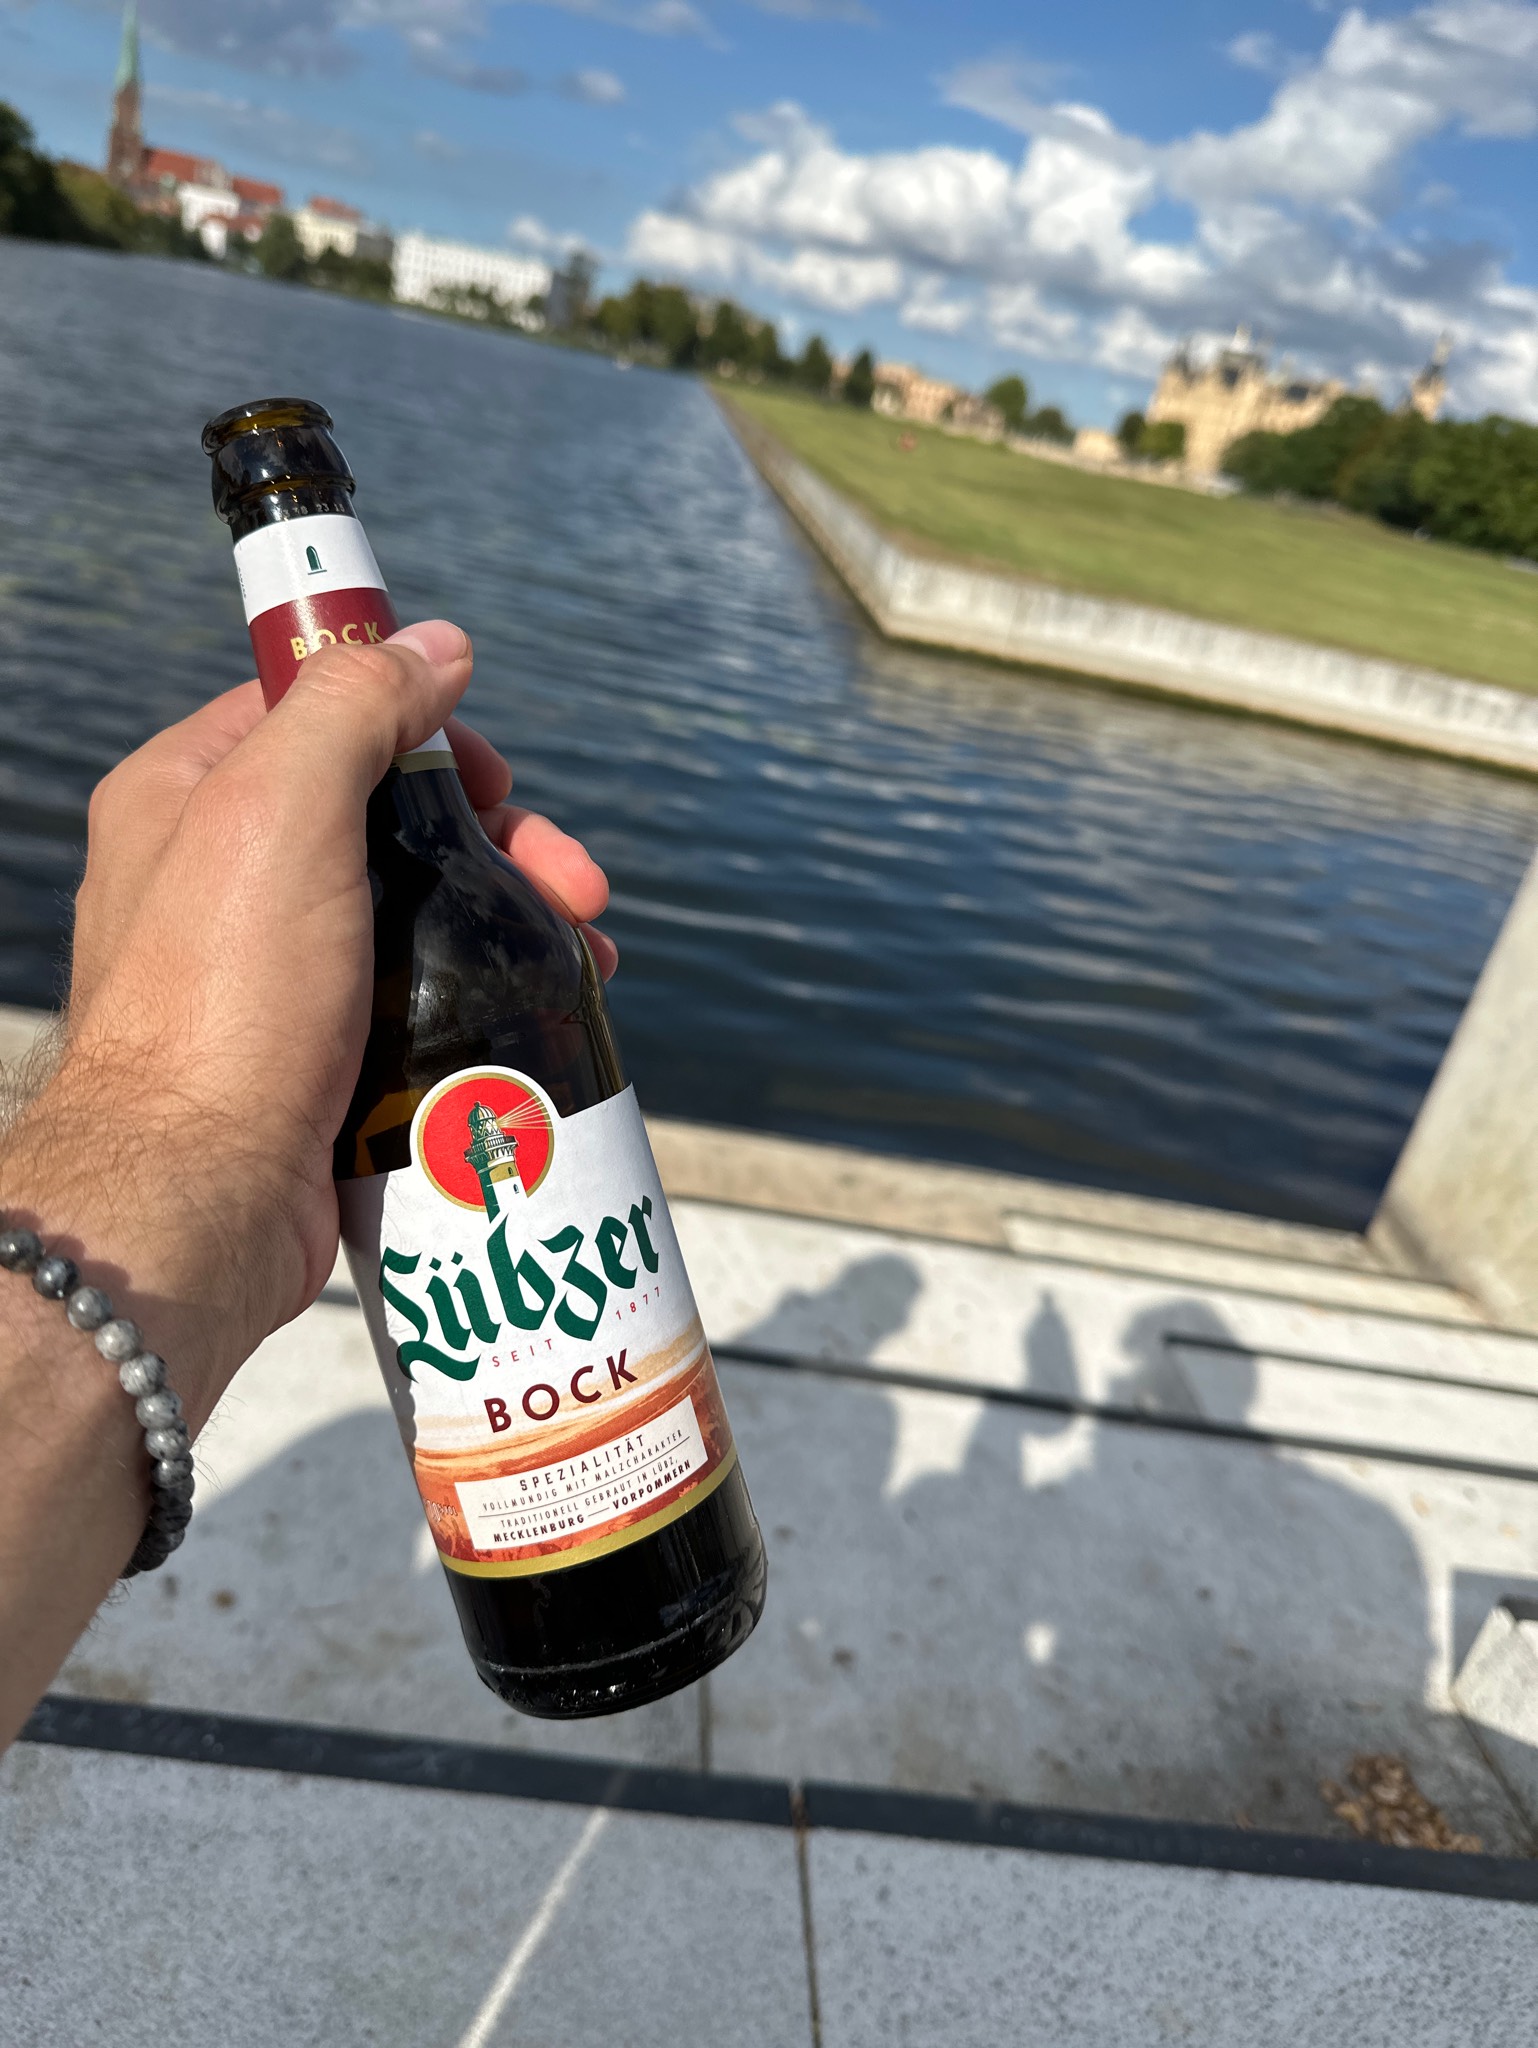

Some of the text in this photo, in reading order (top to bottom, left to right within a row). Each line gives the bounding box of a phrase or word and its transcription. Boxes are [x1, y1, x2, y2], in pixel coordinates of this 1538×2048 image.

[378, 1195, 660, 1384] Lübzer
[492, 1286, 661, 1367] SEIT 1877
[484, 1348, 638, 1433] BOCK
[483, 1429, 682, 1511] VOLLMUNDIG MIT MALZCHARAKTER
[494, 1459, 691, 1542] MECKLENBURG VORPOMMERN
[501, 1502, 579, 1528] TRADITIONELL
[585, 1479, 632, 1506] GEBRAUT
[637, 1473, 648, 1484] IN
[520, 1434, 644, 1491] SPEZIALITÄT
